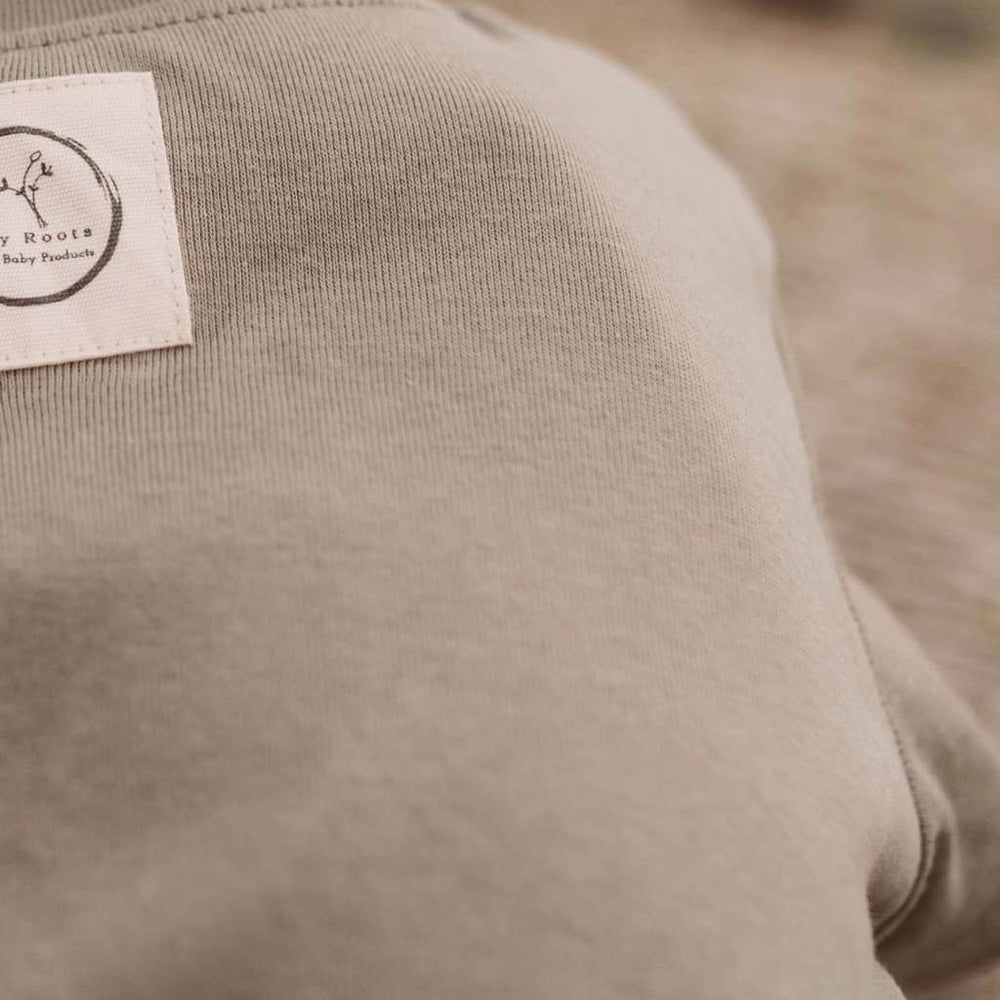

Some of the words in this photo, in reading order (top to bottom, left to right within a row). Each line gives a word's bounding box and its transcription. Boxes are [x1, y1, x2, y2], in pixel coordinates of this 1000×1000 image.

[24, 227, 93, 244] Roots
[3, 253, 36, 266] Baby
[41, 248, 95, 263] Products
